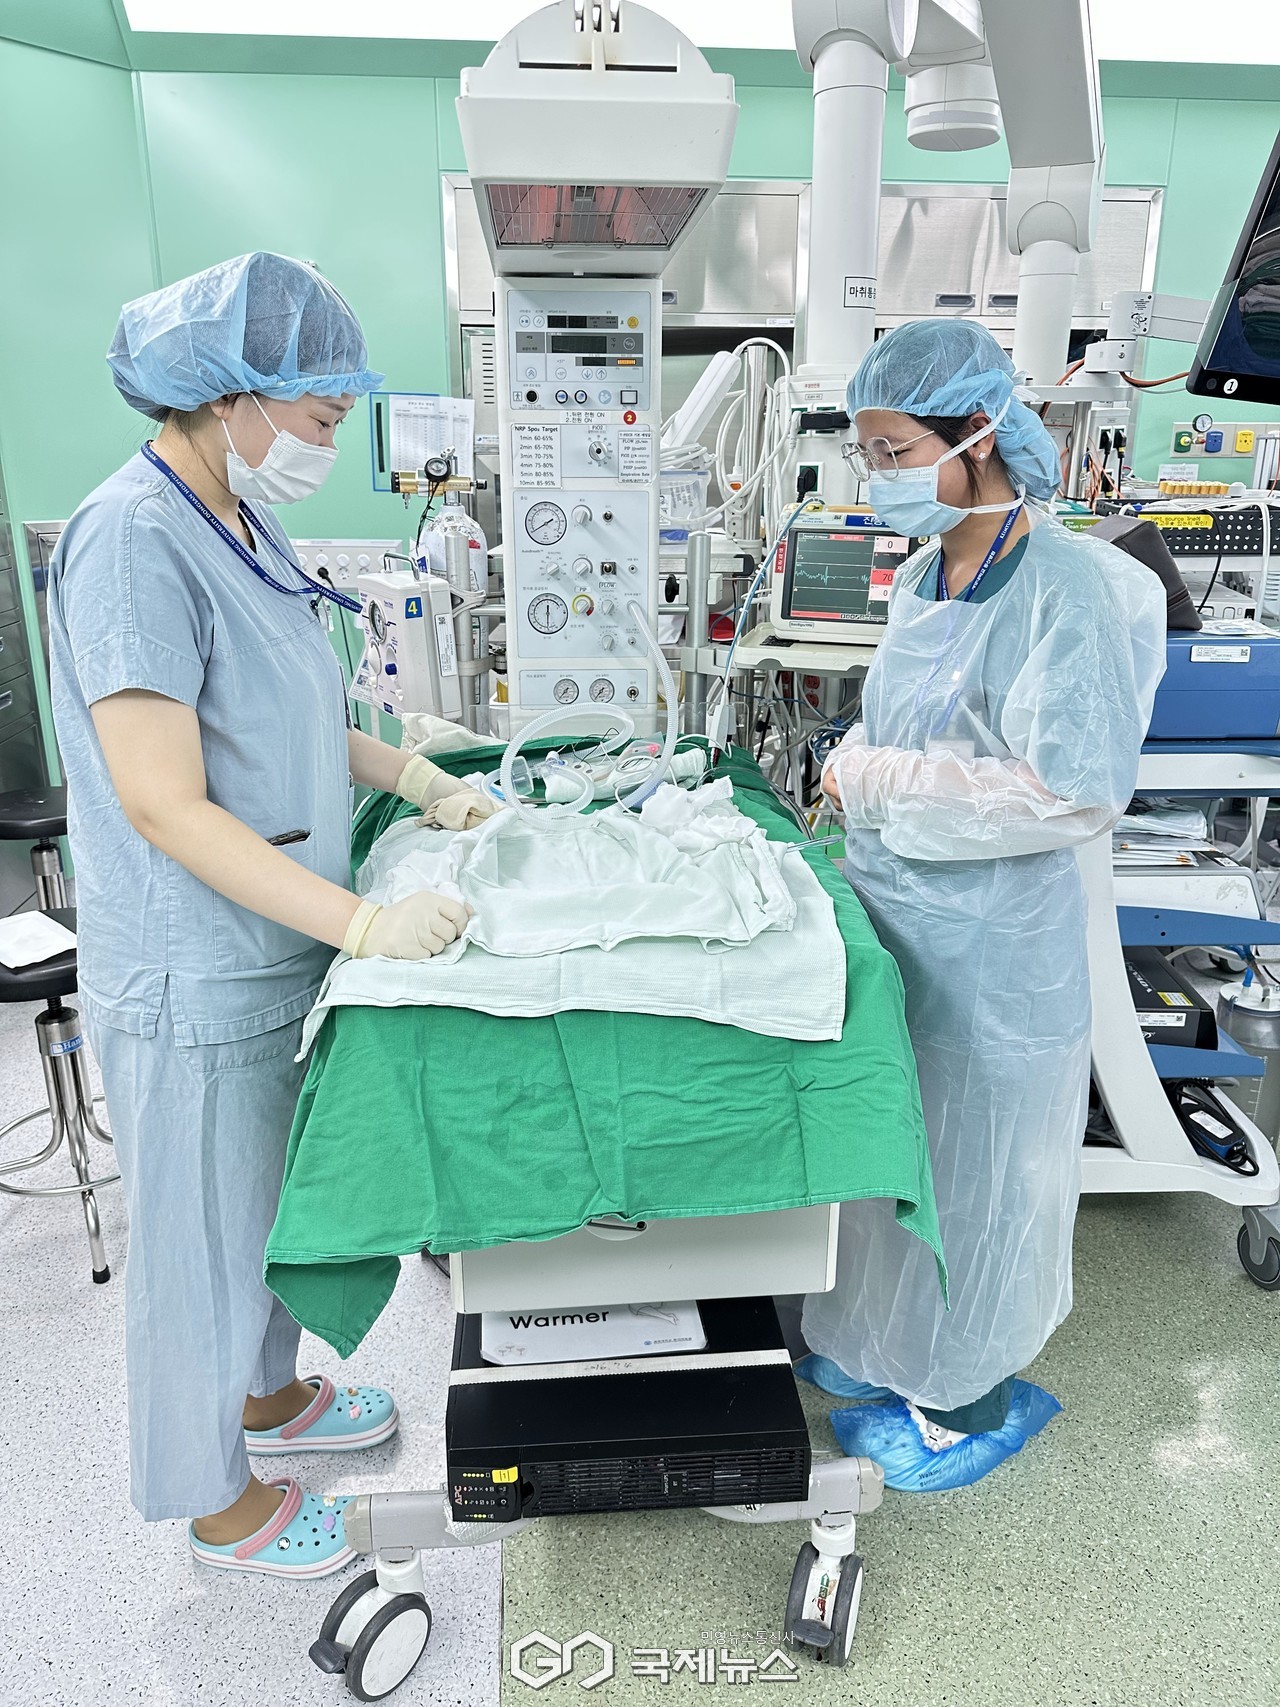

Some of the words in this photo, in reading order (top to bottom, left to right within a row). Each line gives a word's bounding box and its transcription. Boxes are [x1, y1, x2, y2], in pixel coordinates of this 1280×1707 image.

[168, 471, 190, 495] HOSPITAL
[188, 493, 211, 519] DONGSAN
[211, 517, 235, 545] UNIVERSITY
[887, 540, 894, 549] 0
[882, 573, 894, 582] 70
[882, 589, 889, 597] 0
[407, 600, 418, 615] 4
[508, 1309, 610, 1330] Warmer
[454, 1485, 463, 1506] APC
